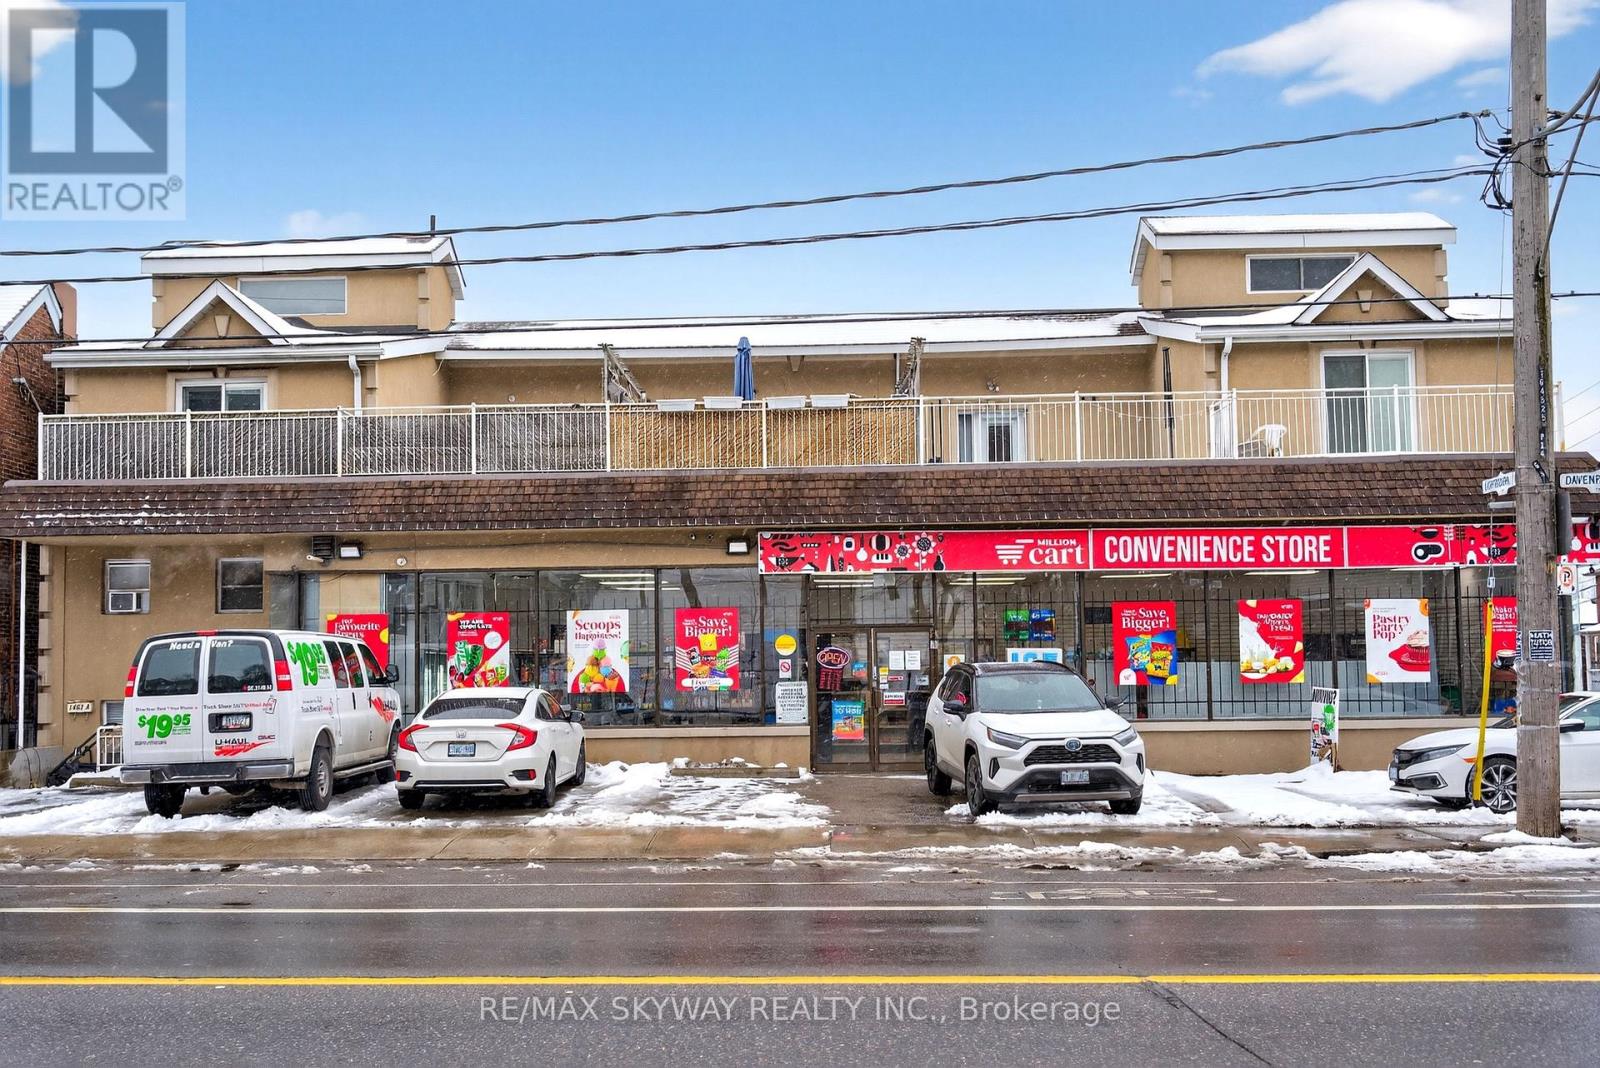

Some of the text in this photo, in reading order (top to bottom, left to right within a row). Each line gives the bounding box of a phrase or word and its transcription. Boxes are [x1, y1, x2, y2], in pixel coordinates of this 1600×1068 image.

[1037, 538, 1077, 546] MILLION
[1028, 544, 1085, 565] cart
[1104, 535, 1332, 563] CONVENIENCE STORE
[1139, 608, 1167, 618] Save
[698, 616, 728, 627] Save
[1122, 617, 1170, 631] Bigger!
[1373, 614, 1411, 626] Pastry
[575, 620, 621, 633] Scoops
[1373, 622, 1405, 634] Party
[575, 631, 621, 641] Happiness!
[1374, 630, 1396, 642] Pop
[169, 641, 194, 651] Need
[210, 640, 234, 648] Van?
[820, 651, 847, 664] OPEN
